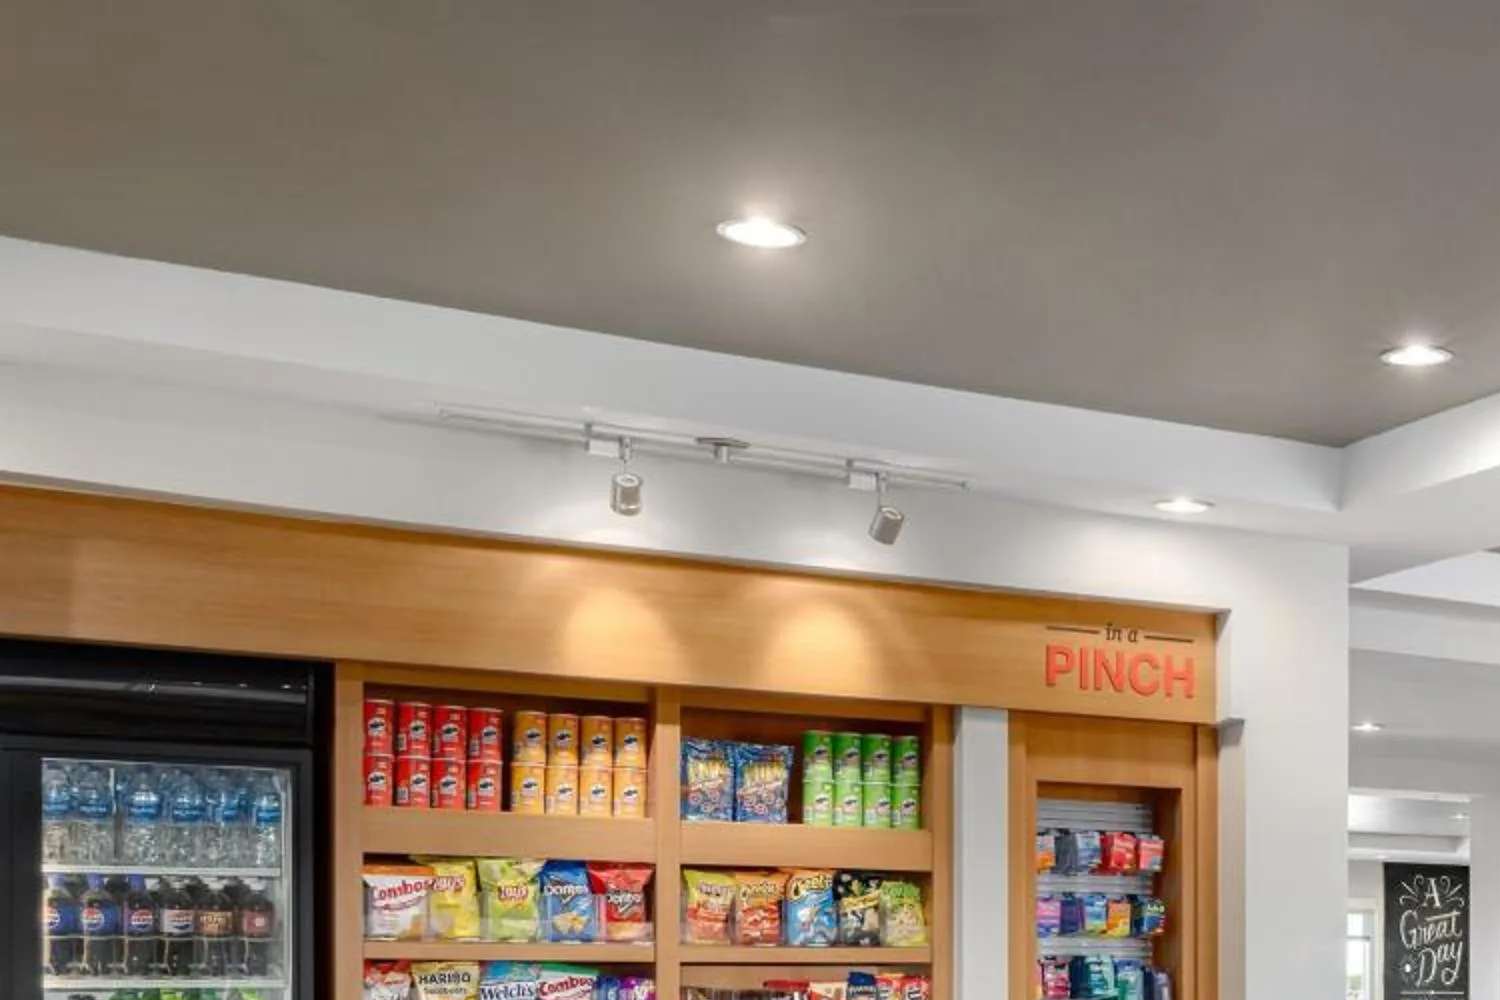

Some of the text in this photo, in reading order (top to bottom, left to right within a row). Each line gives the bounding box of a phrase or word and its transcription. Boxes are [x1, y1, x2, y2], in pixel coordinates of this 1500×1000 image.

[1105, 623, 1139, 643] in a
[1045, 643, 1195, 700] PINCH
[1422, 877, 1442, 908] A
[1401, 909, 1464, 950] Great
[418, 972, 472, 986] HARIBO
[1416, 941, 1464, 987] Day
